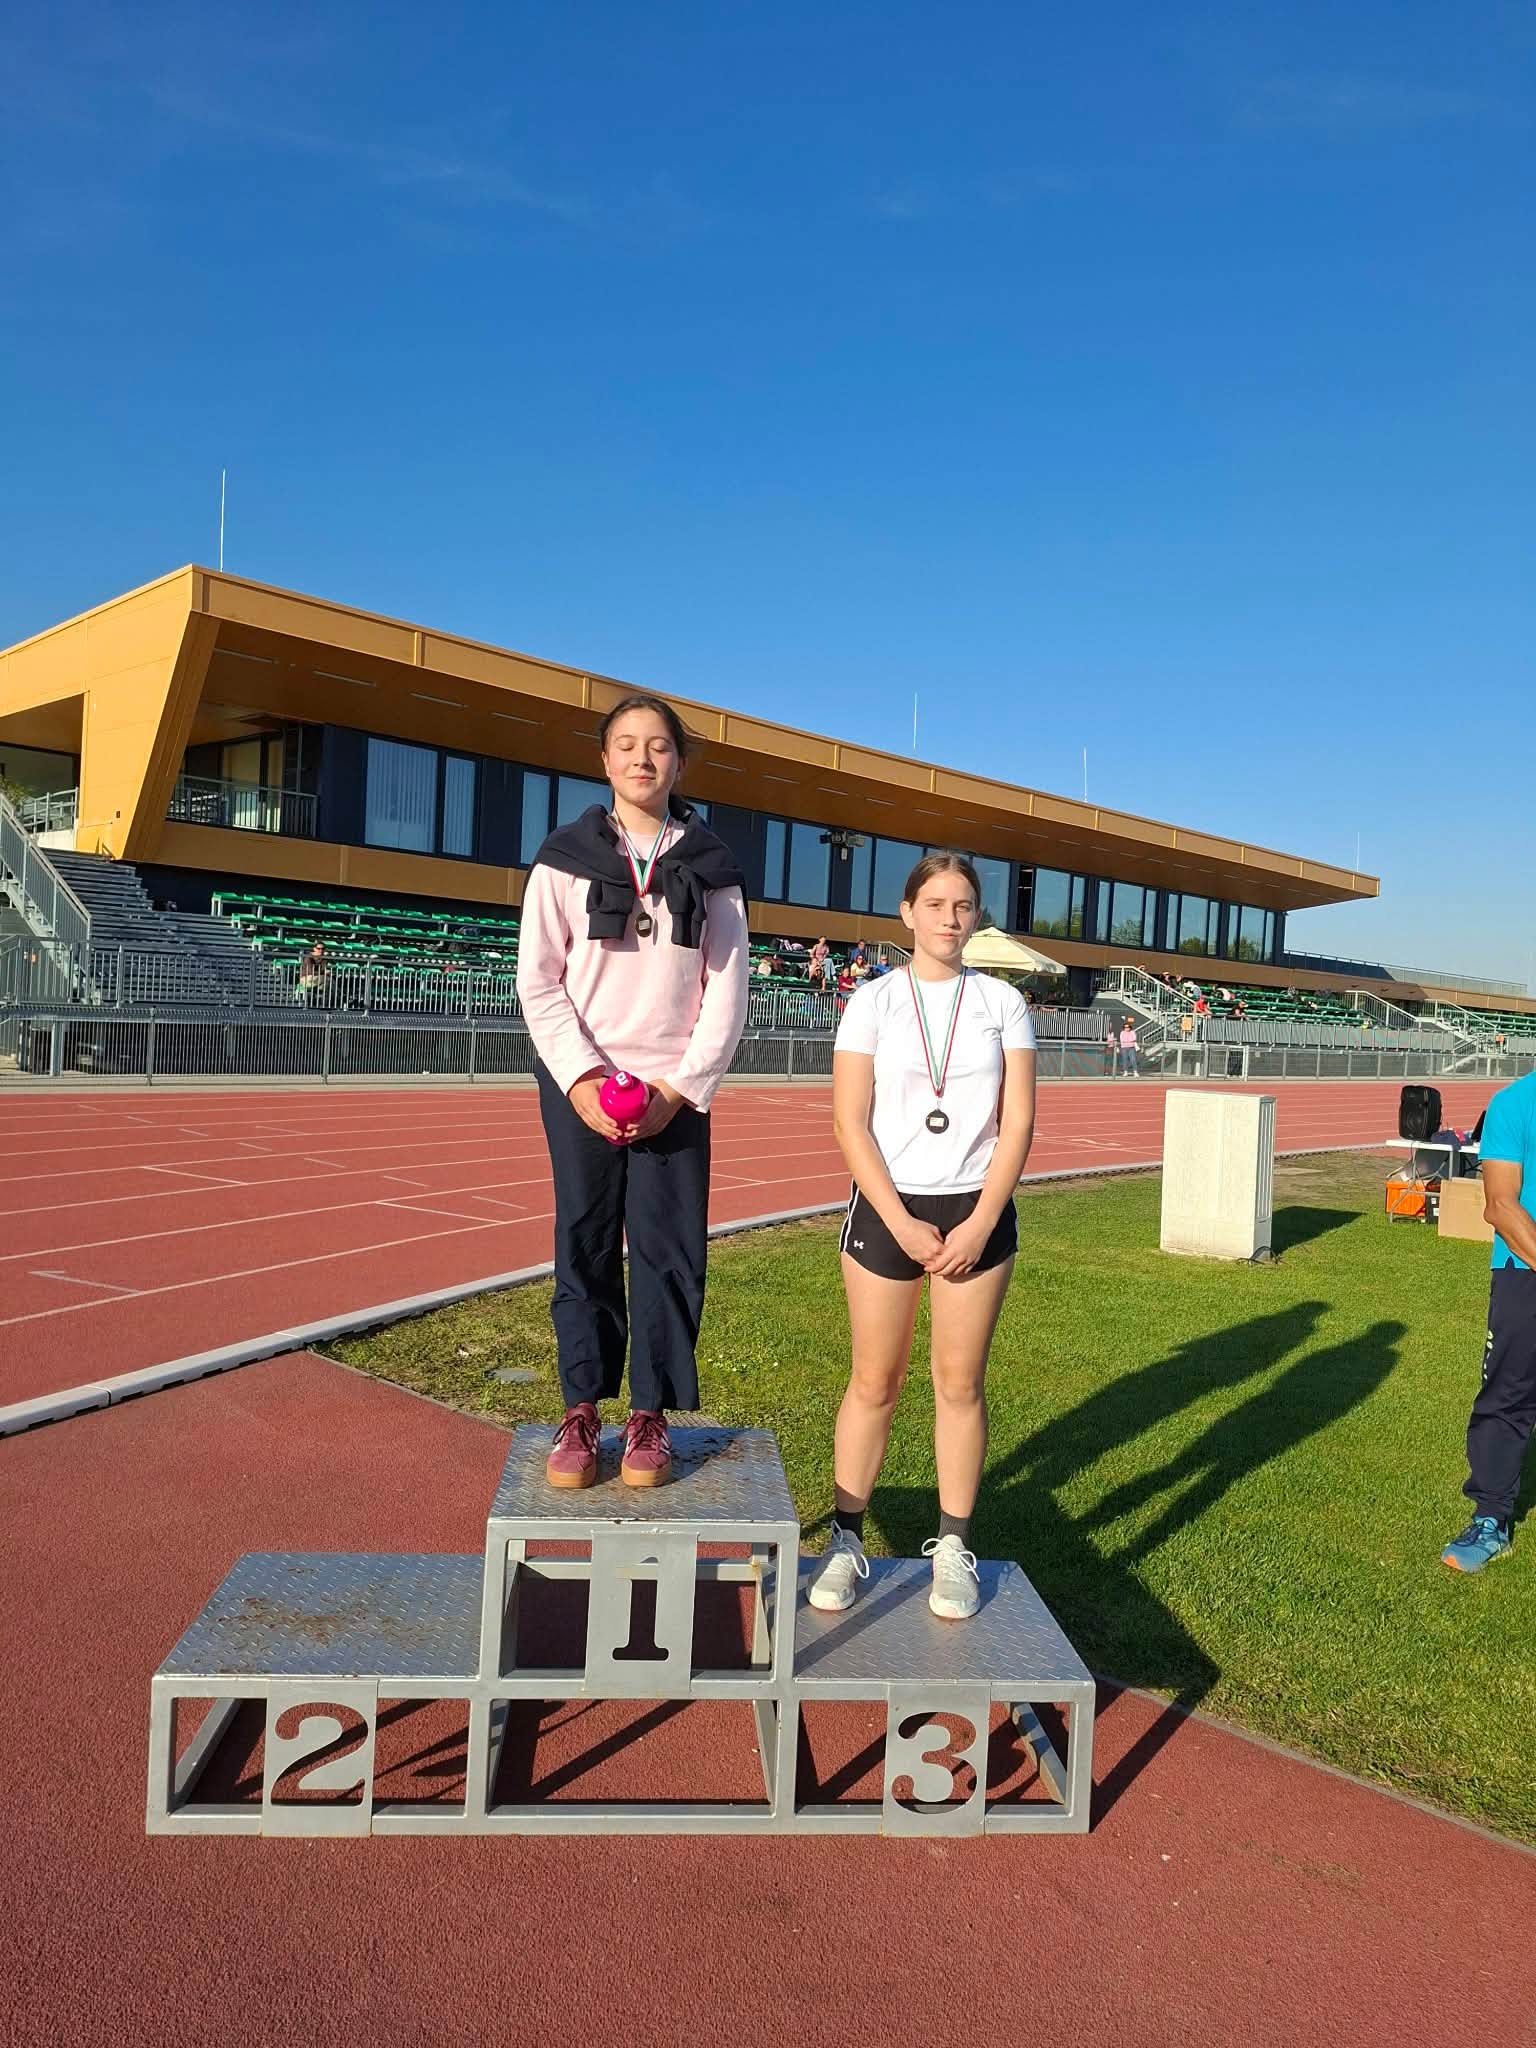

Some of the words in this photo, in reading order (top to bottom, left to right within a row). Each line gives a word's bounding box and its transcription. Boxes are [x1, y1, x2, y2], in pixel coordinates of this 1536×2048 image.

[611, 1556, 669, 1661] 1
[271, 1702, 369, 1806] 2
[891, 1711, 977, 1815] 3
